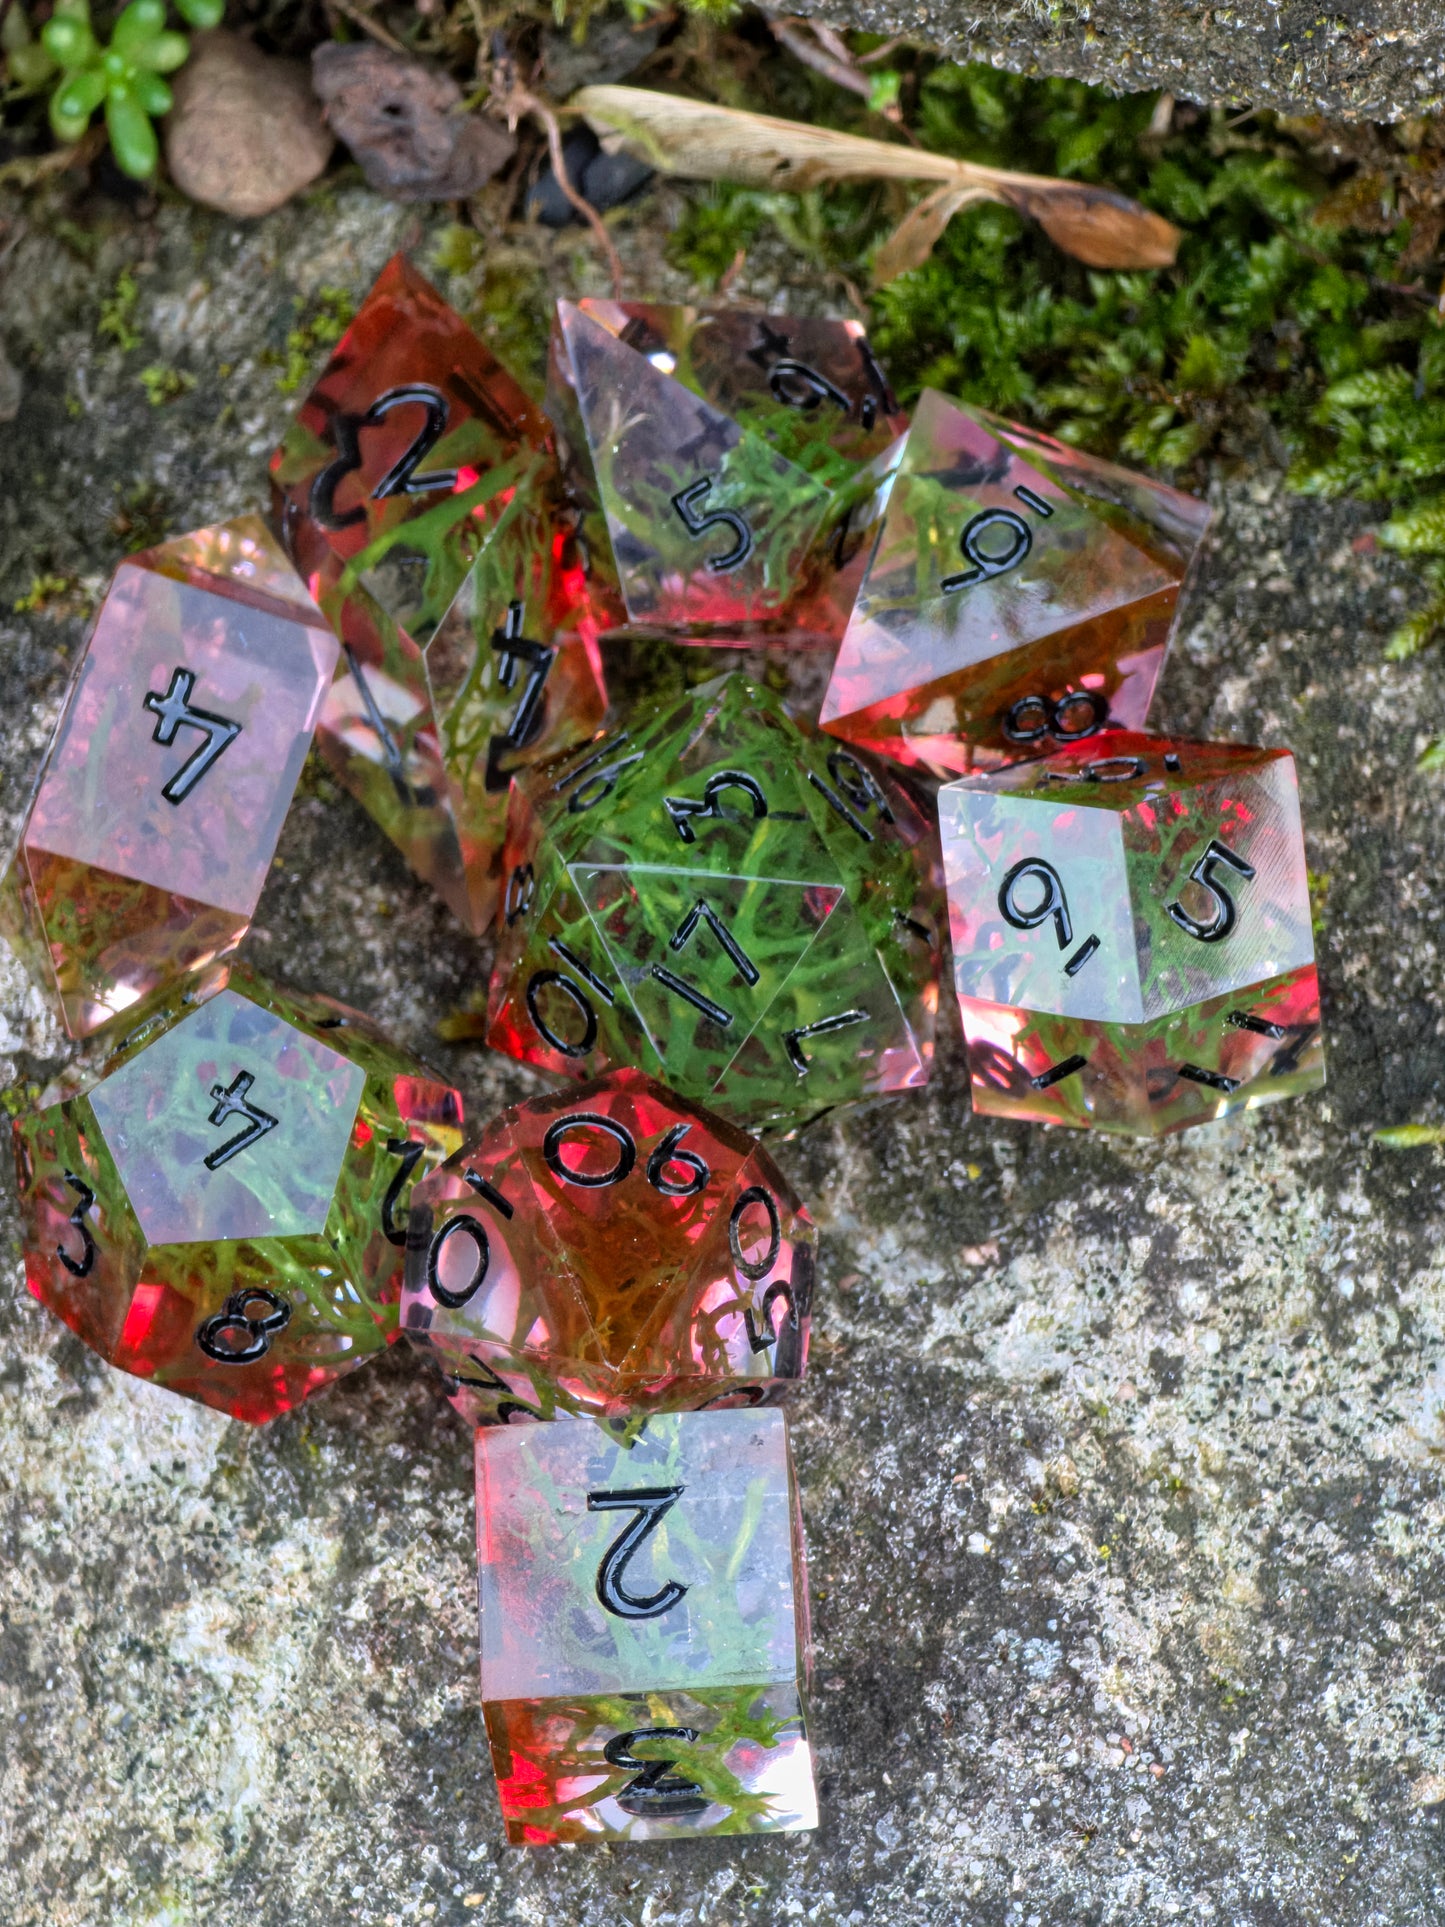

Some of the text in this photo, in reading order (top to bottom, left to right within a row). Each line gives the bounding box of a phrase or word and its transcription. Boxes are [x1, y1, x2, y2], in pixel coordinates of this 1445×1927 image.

[368, 382, 458, 500] 2
[671, 476, 754, 573] 5
[143, 667, 242, 806] 4
[1005, 691, 1109, 742] 8
[1165, 839, 1257, 943] 5
[203, 1070, 279, 1171] 4
[56, 1168, 95, 1277] 3
[197, 1288, 292, 1363] 8
[587, 1485, 689, 1620] 2
